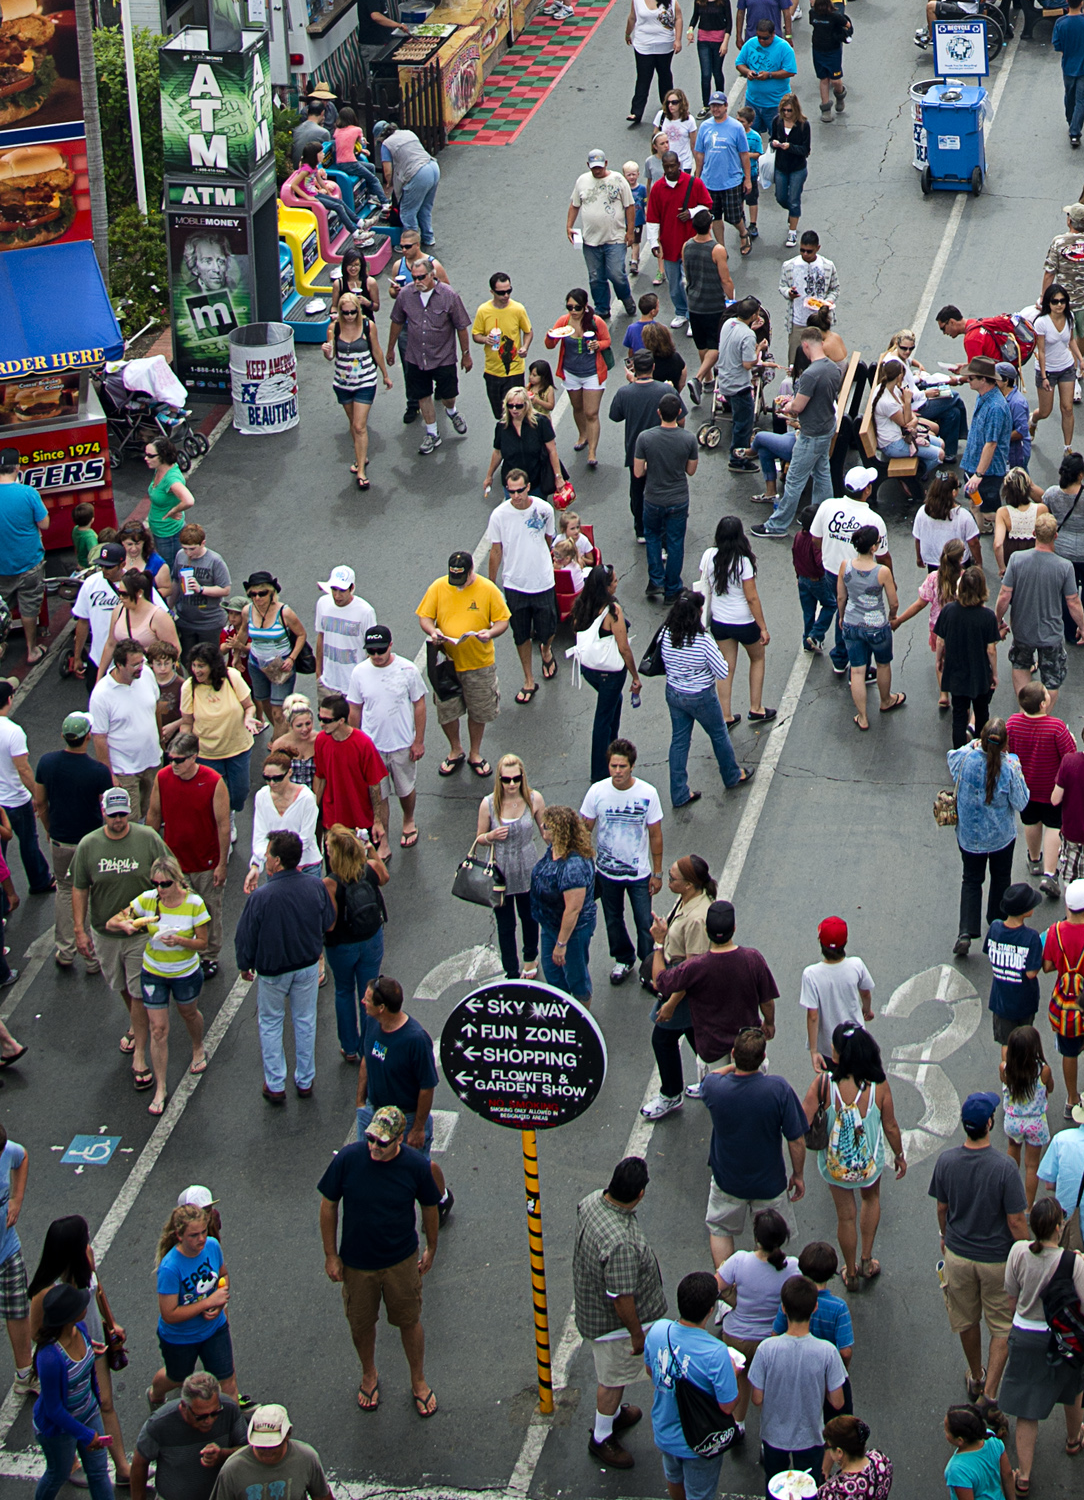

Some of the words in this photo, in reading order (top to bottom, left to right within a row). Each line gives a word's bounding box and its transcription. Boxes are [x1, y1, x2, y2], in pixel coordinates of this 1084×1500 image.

[188, 63, 229, 169] ATM
[253, 52, 272, 164] ATM
[181, 186, 236, 206] ATM
[52, 347, 106, 367] HERE
[246, 359, 266, 380] KEEP
[33, 449, 65, 463] Since
[68, 441, 101, 458] 1974
[487, 999, 525, 1015] SKY
[533, 1002, 570, 1019] WAY
[481, 1024, 517, 1039] FUN
[525, 1027, 577, 1044] ZONE
[483, 1047, 577, 1067] SHOPPING
[491, 1069, 552, 1083] FLOWER
[558, 1074, 569, 1085] &
[475, 1080, 536, 1093] GARDEN
[542, 1084, 587, 1098] SHOW
[488, 1099, 504, 1108] NO
[509, 1100, 559, 1111] SMOKING
[500, 1112, 530, 1120] DESIGNATED
